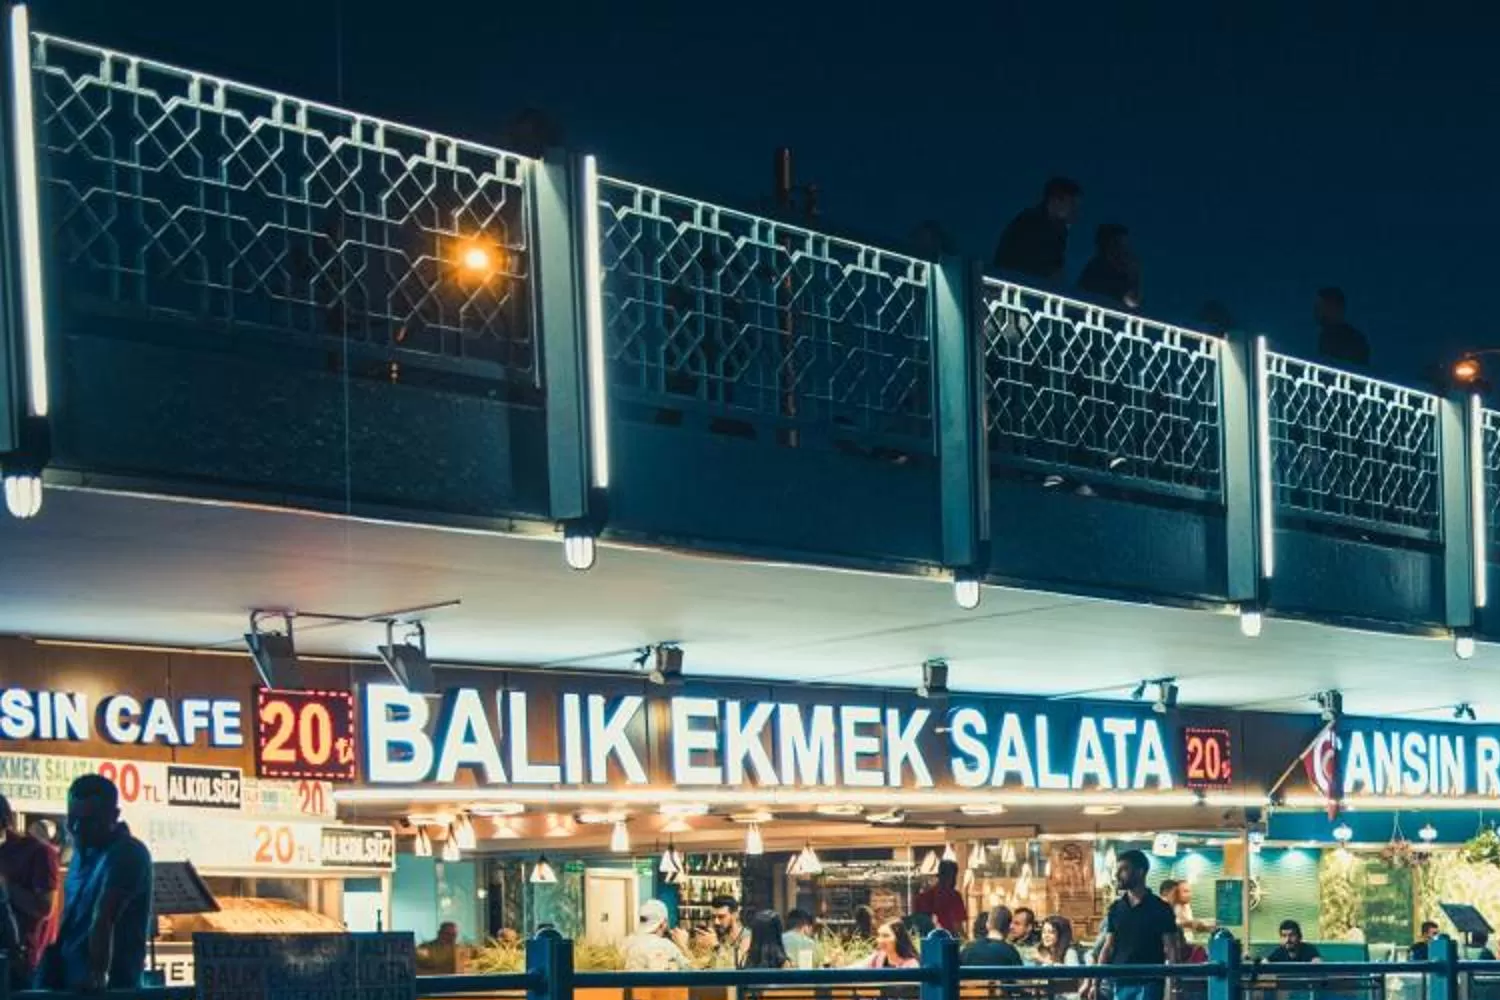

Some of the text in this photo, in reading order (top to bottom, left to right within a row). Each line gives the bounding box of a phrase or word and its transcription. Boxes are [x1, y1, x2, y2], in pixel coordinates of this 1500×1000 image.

[0, 688, 243, 746] SIN CAFE
[261, 700, 333, 765] 20
[367, 683, 1173, 789] BALIK EKMEK SALATA
[1187, 736, 1221, 779] 20
[1331, 730, 1467, 795] ANSIN
[144, 785, 162, 804] TL
[169, 773, 241, 804] ALKOLSÜZ
[255, 825, 295, 864] 20
